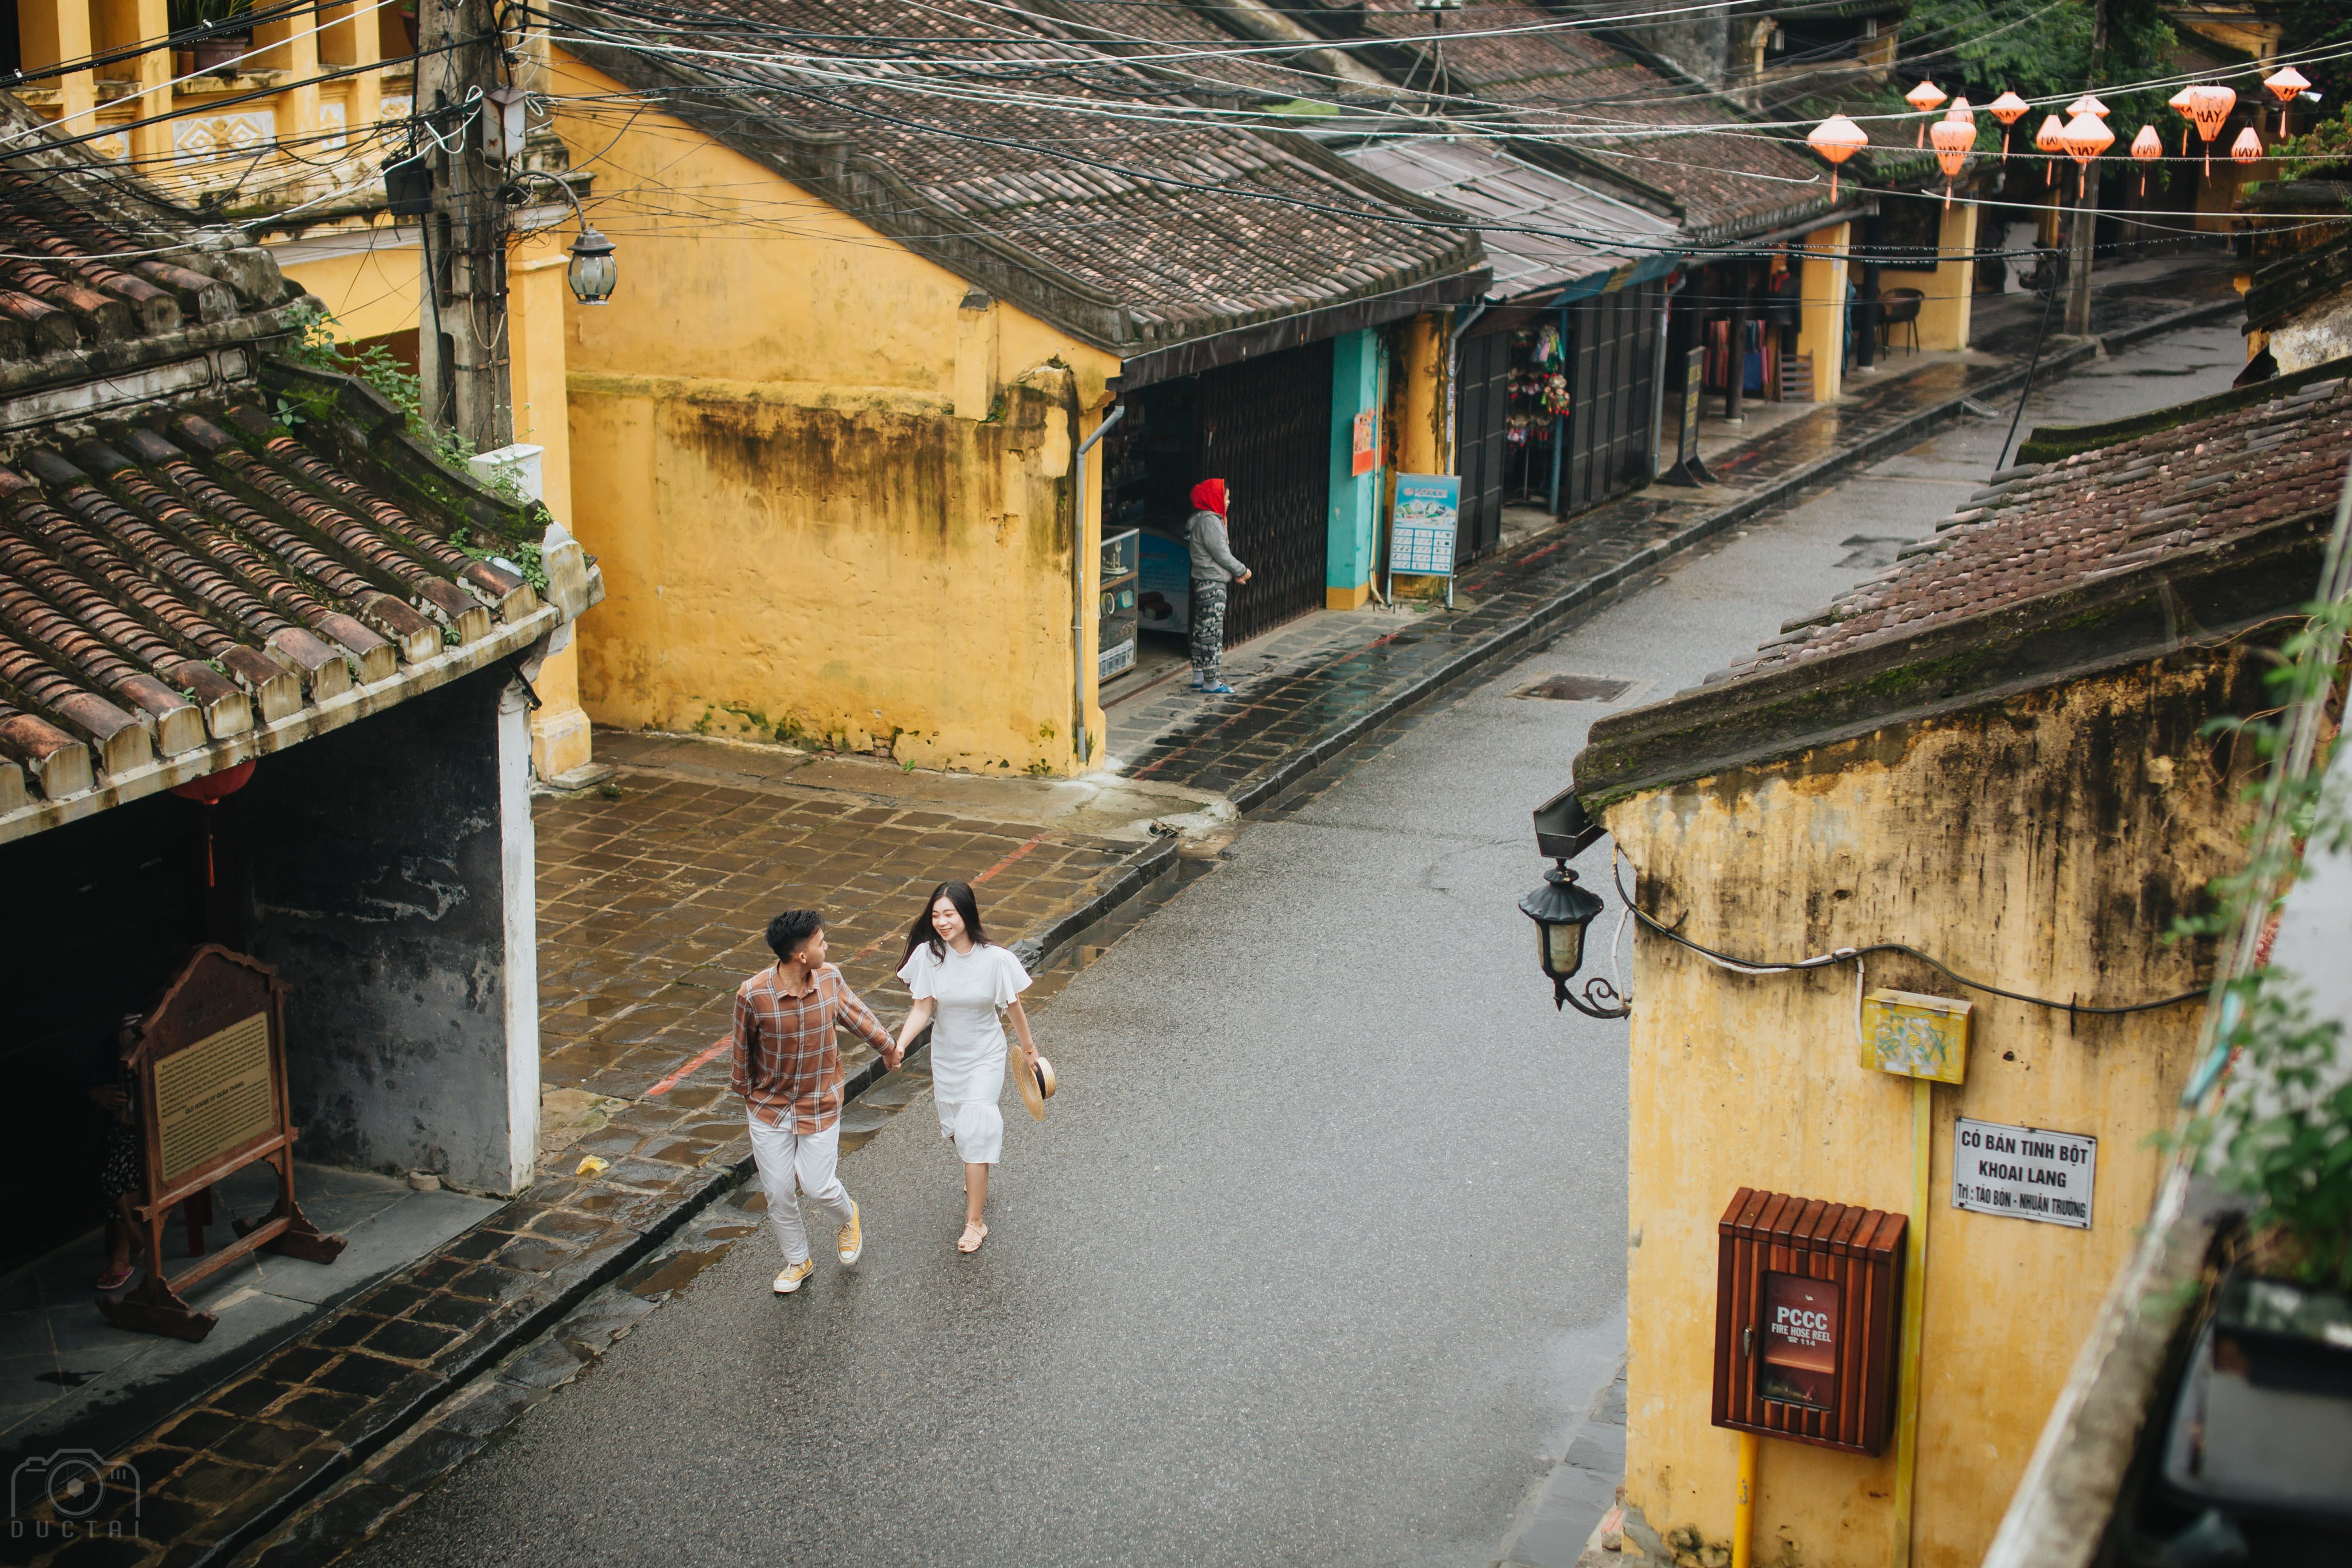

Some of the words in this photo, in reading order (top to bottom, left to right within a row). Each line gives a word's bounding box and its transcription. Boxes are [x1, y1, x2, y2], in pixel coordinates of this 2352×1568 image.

[2196, 110, 2222, 122] MAY
[184, 1105, 195, 1114] OLD
[195, 1098, 210, 1109] HOUSE
[210, 1094, 216, 1102] OF
[1961, 1129, 1980, 1148] CÓ
[1986, 1133, 2015, 1154] BÁN
[2021, 1140, 2054, 1159] TINH
[2059, 1144, 2088, 1167] BỘT
[1979, 1160, 2023, 1181] KHOAI
[2027, 1167, 2067, 1188] LANG
[1777, 1306, 1828, 1330] PCCC
[1771, 1322, 1789, 1335] FIRE
[1790, 1326, 1810, 1339] HOSE
[1812, 1330, 1832, 1342] REEL
[1800, 1338, 1816, 1347] 114
